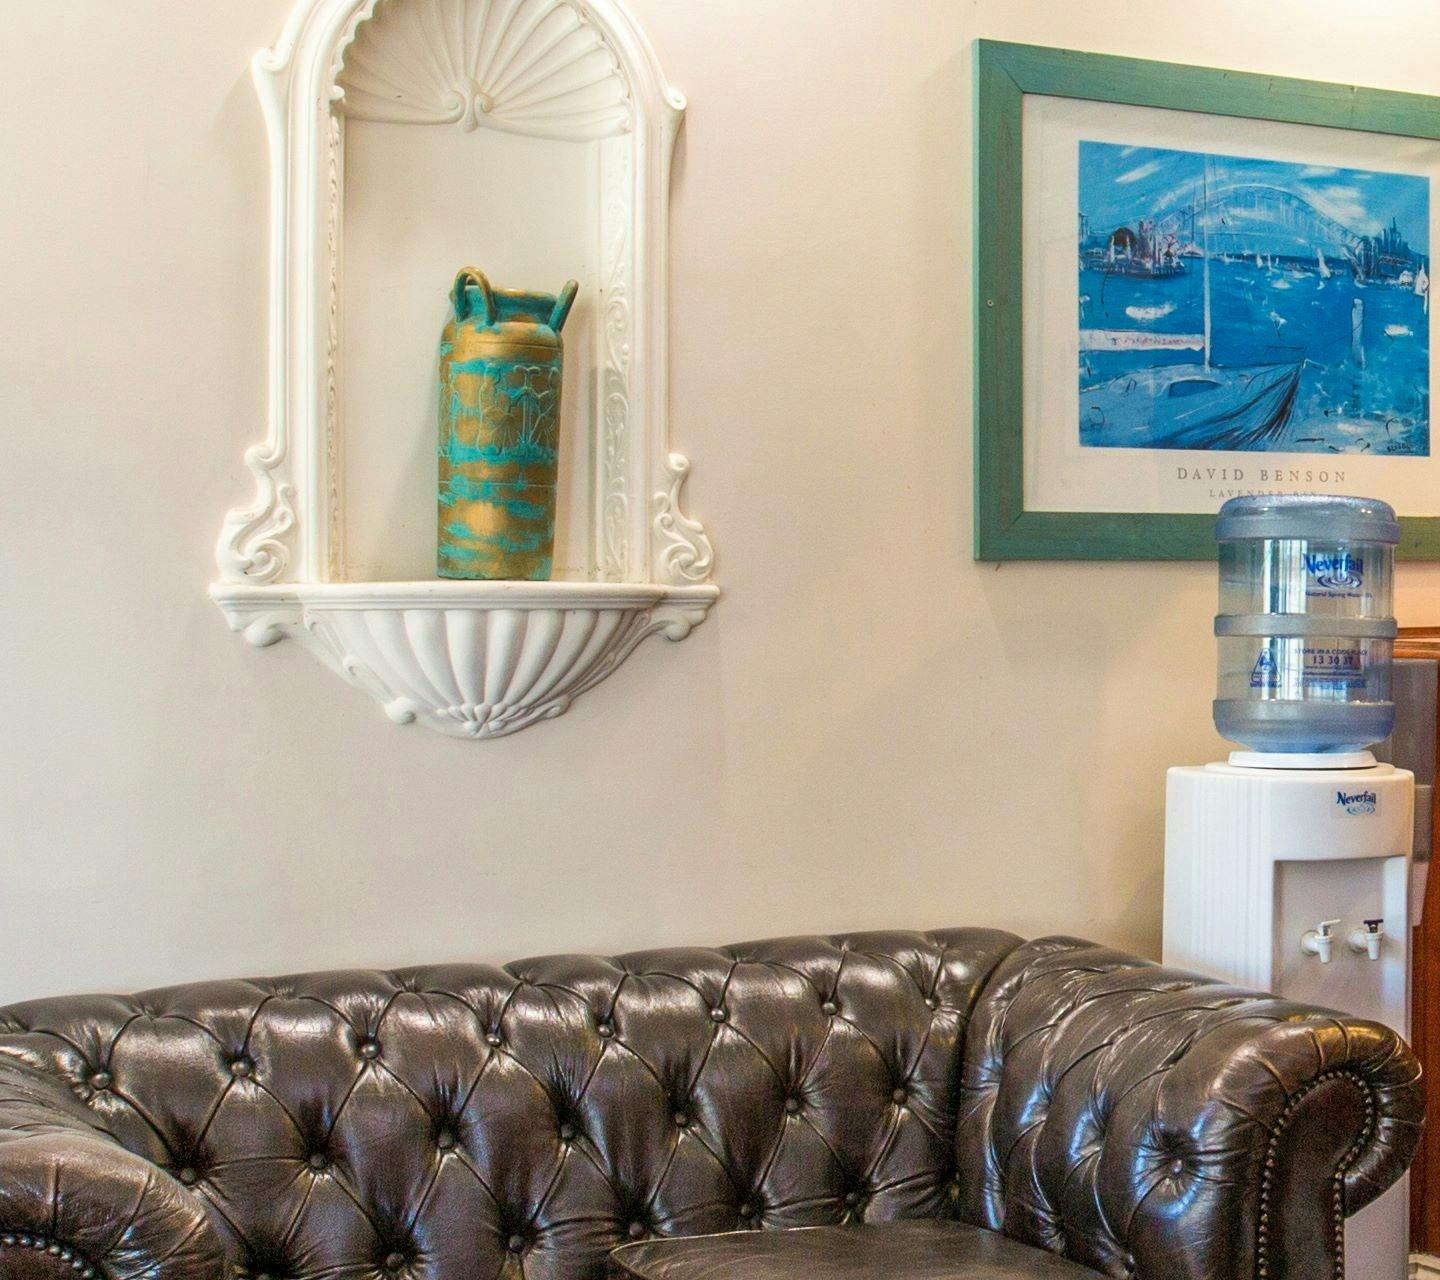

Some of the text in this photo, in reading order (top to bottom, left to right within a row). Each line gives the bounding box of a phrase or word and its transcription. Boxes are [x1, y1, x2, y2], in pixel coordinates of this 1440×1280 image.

[1177, 467, 1346, 483] DAVID BENSON
[1302, 553, 1363, 575] Neverfail
[1336, 790, 1377, 806] Neverfail
